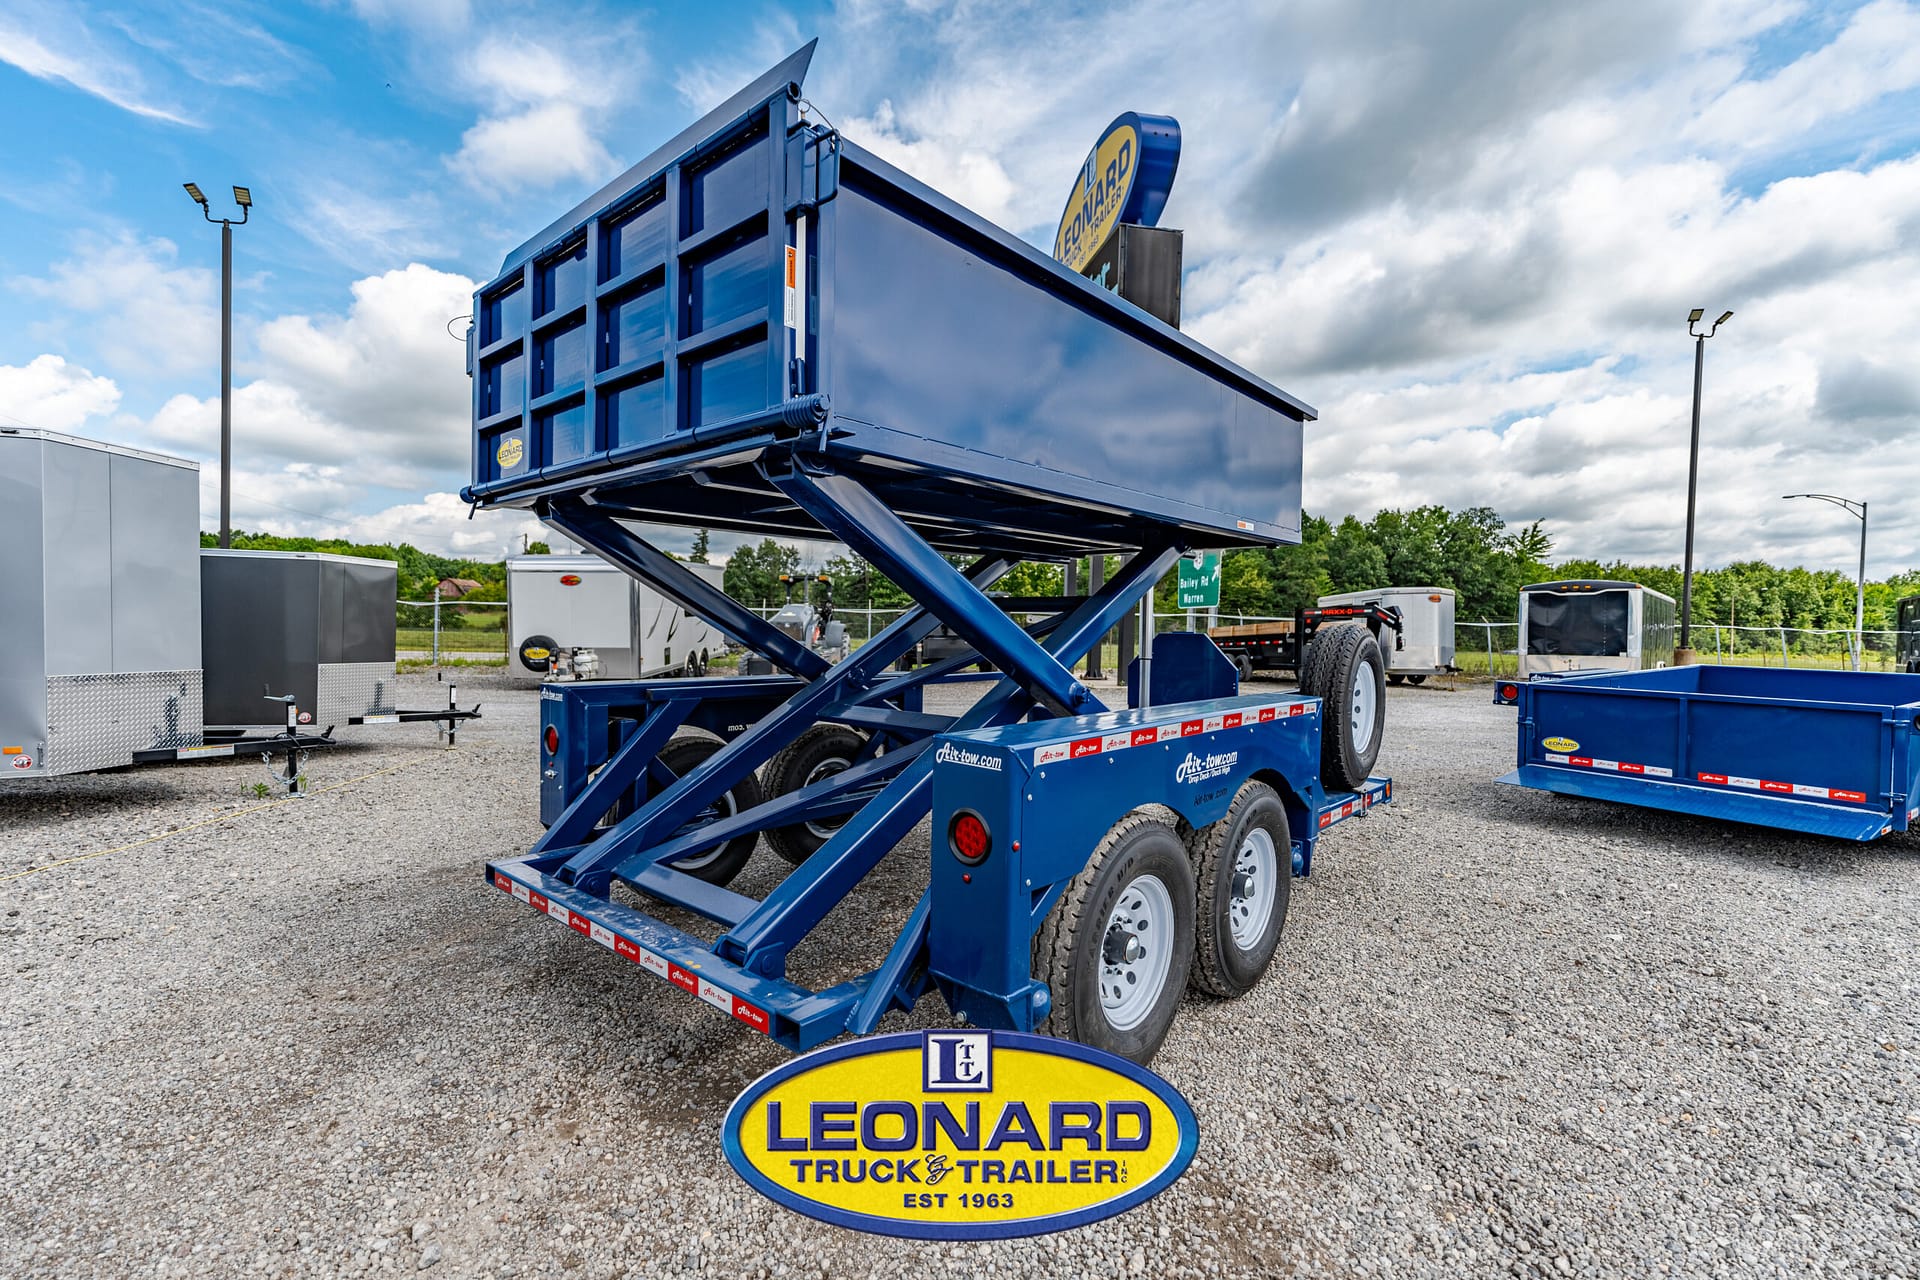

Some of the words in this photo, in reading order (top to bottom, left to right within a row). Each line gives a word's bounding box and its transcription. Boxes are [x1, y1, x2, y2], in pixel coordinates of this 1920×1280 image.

[1057, 138, 1131, 264] LEONARD
[1090, 184, 1122, 238] TRAILER
[1180, 577, 1199, 590] Bailey
[1201, 575, 1209, 587] Rd
[1183, 593, 1204, 604] Warren
[1321, 608, 1353, 616] MAXX-D
[936, 742, 1002, 769] Air-tow.com
[1040, 750, 1064, 763] Air-tow
[1075, 744, 1098, 757] Air-tow
[1106, 739, 1127, 750] Air-tow
[1176, 752, 1238, 783] Air-tow.com
[672, 970, 694, 986] Air-tow
[703, 987, 727, 1003] Air-tow
[737, 1005, 763, 1024] Air-tow
